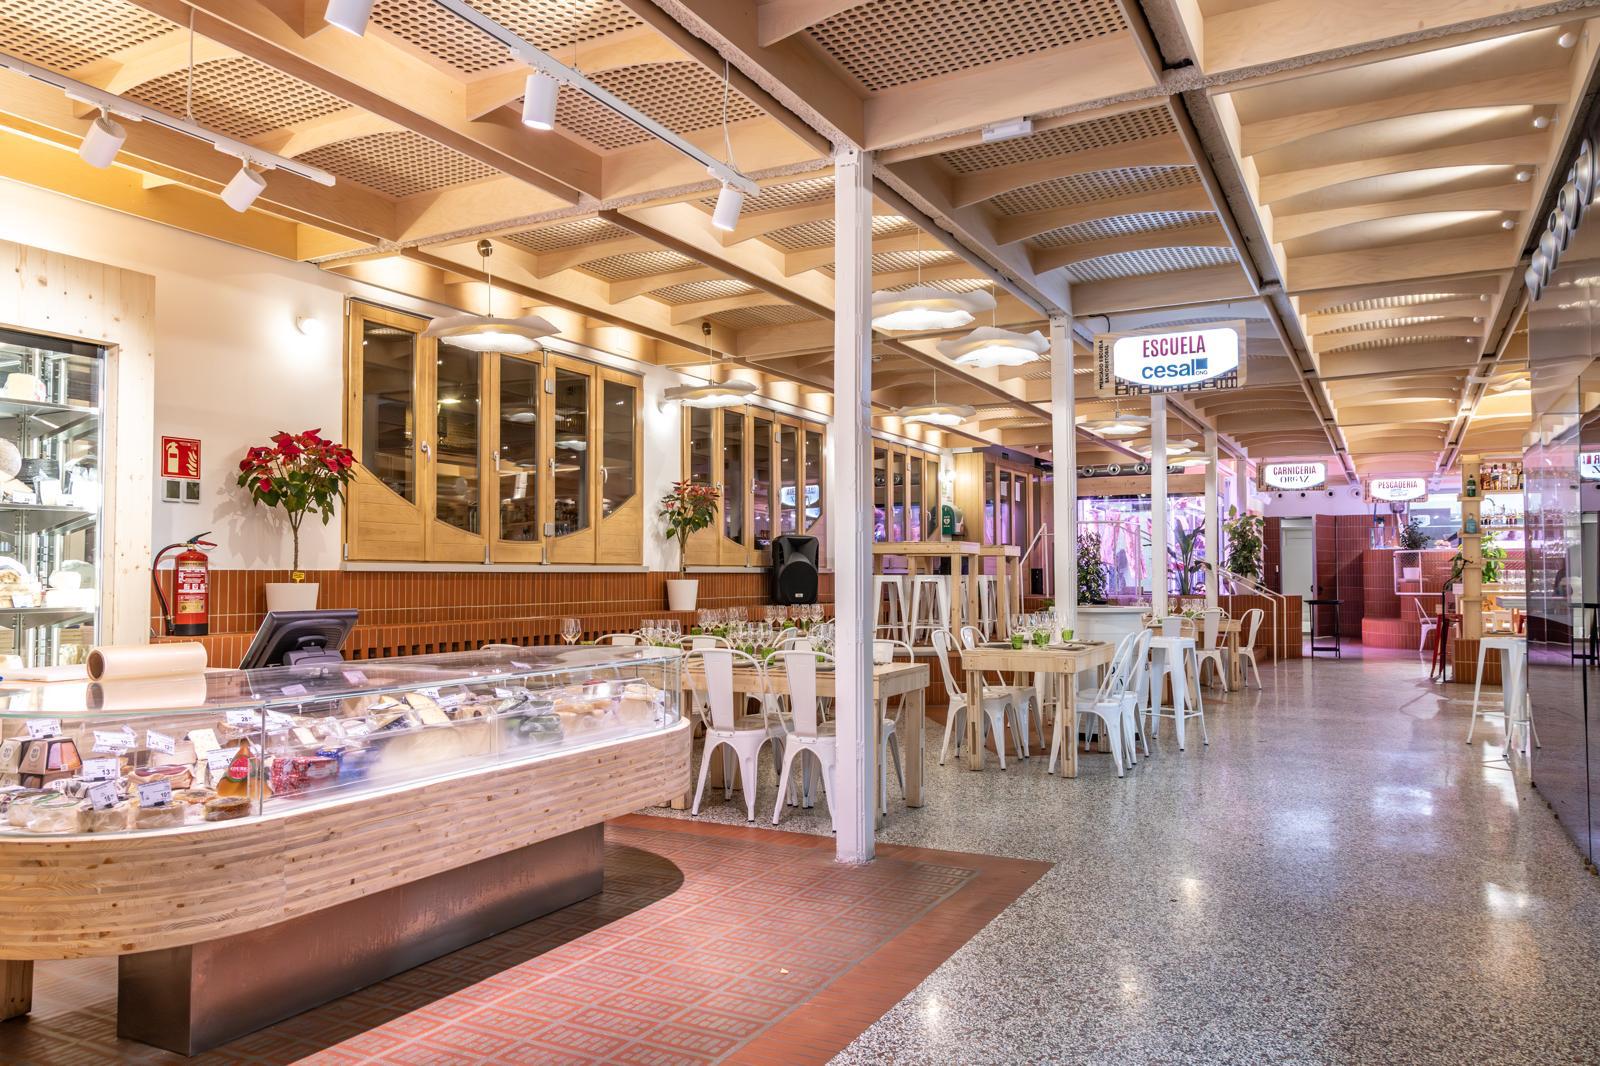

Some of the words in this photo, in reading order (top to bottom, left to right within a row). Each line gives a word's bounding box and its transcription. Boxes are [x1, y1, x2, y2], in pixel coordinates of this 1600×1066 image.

[1143, 335, 1206, 358] ESCUELA
[1142, 359, 1195, 379] cesal
[1273, 465, 1316, 476] CARNICERIA
[1279, 475, 1309, 483] ORGAZ
[1378, 480, 1418, 489] PESCADERIA
